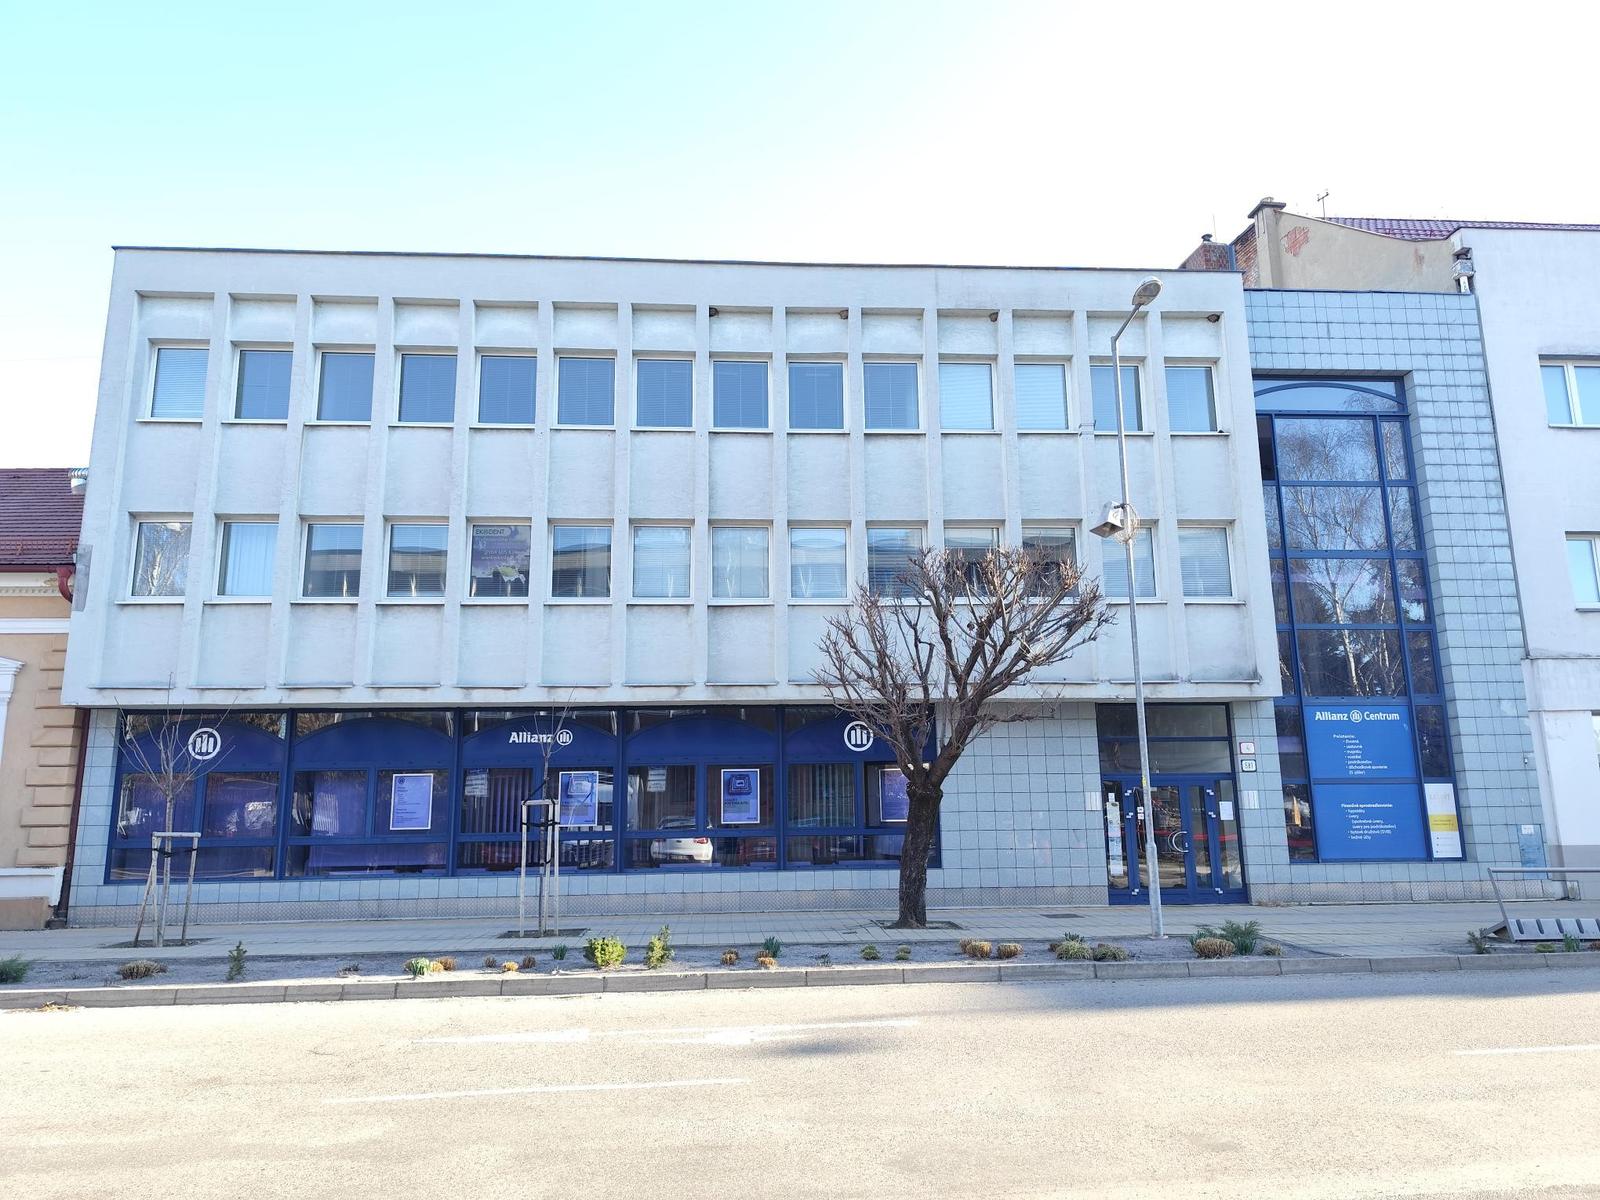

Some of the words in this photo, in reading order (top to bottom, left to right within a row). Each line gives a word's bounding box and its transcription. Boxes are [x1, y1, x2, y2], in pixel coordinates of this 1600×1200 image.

[1315, 711, 1349, 721] Allianz
[1364, 711, 1400, 721] Centrum
[508, 731, 554, 744] Allianz
